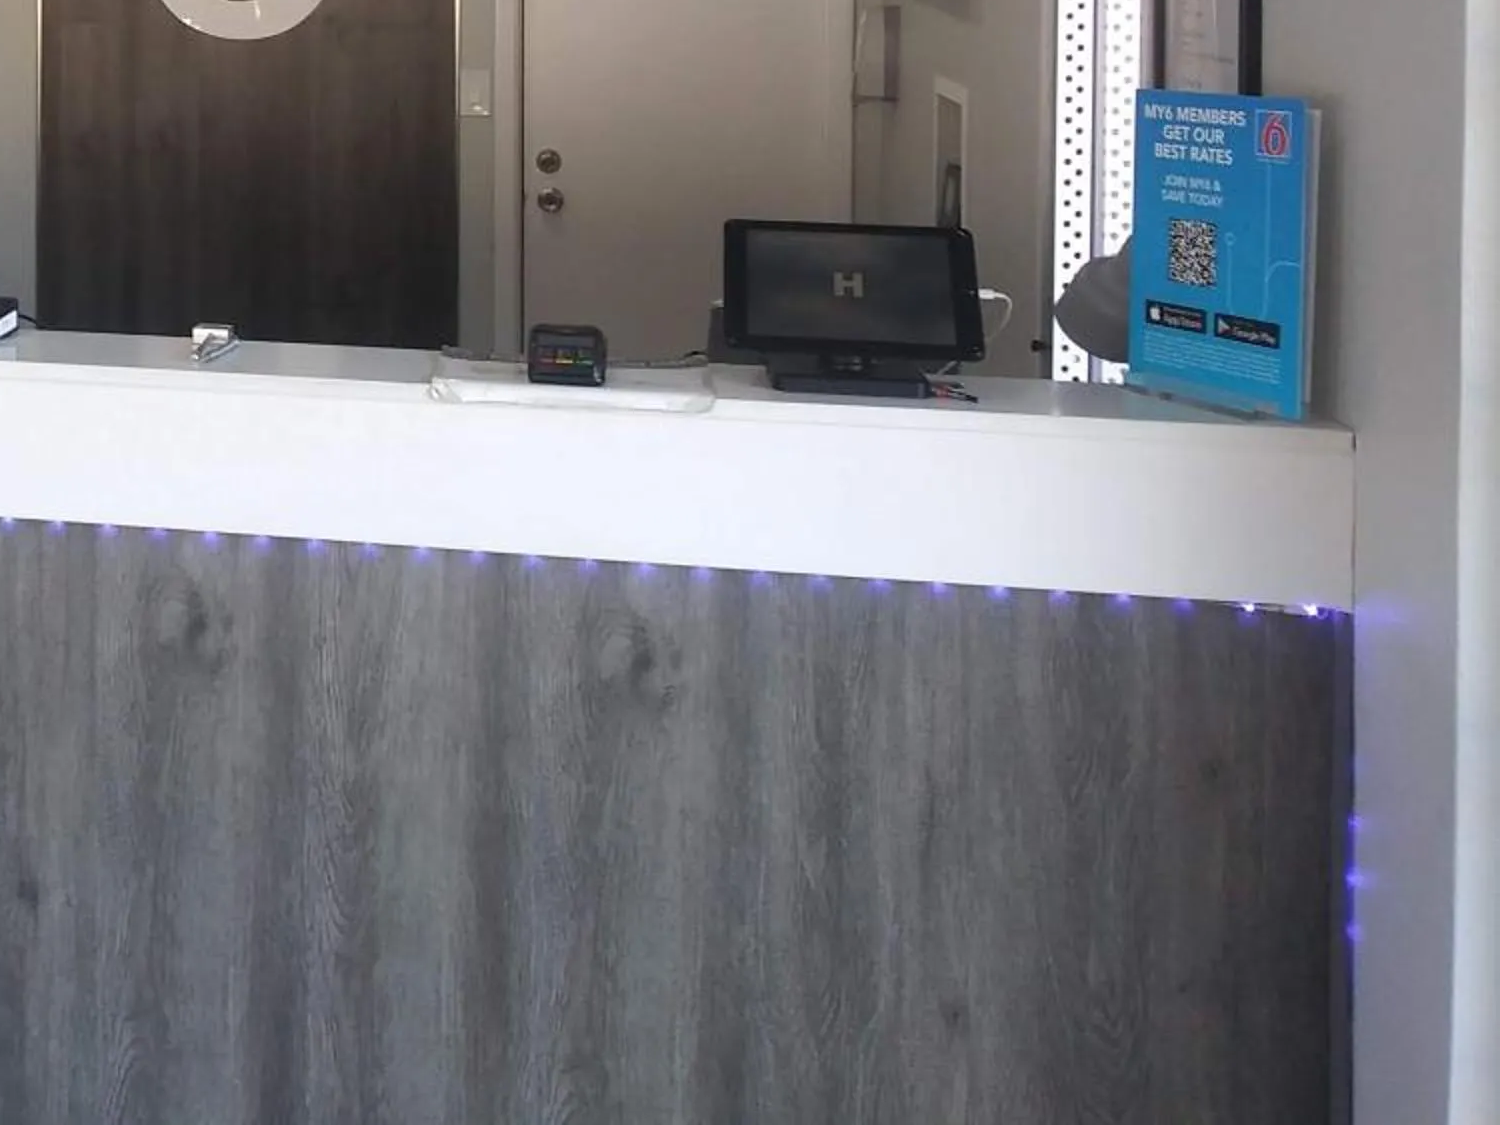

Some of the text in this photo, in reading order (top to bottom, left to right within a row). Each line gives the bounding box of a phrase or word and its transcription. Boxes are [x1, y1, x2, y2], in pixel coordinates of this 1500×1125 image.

[1144, 103, 1247, 126] MY6 MEMBERS
[1163, 124, 1225, 145] GET OUR
[1261, 114, 1290, 156] 6
[1154, 142, 1233, 165] BEST RATES
[1163, 174, 1188, 189] JOIN
[1161, 188, 1224, 207] SAVE TODAY
[833, 272, 864, 298] H
